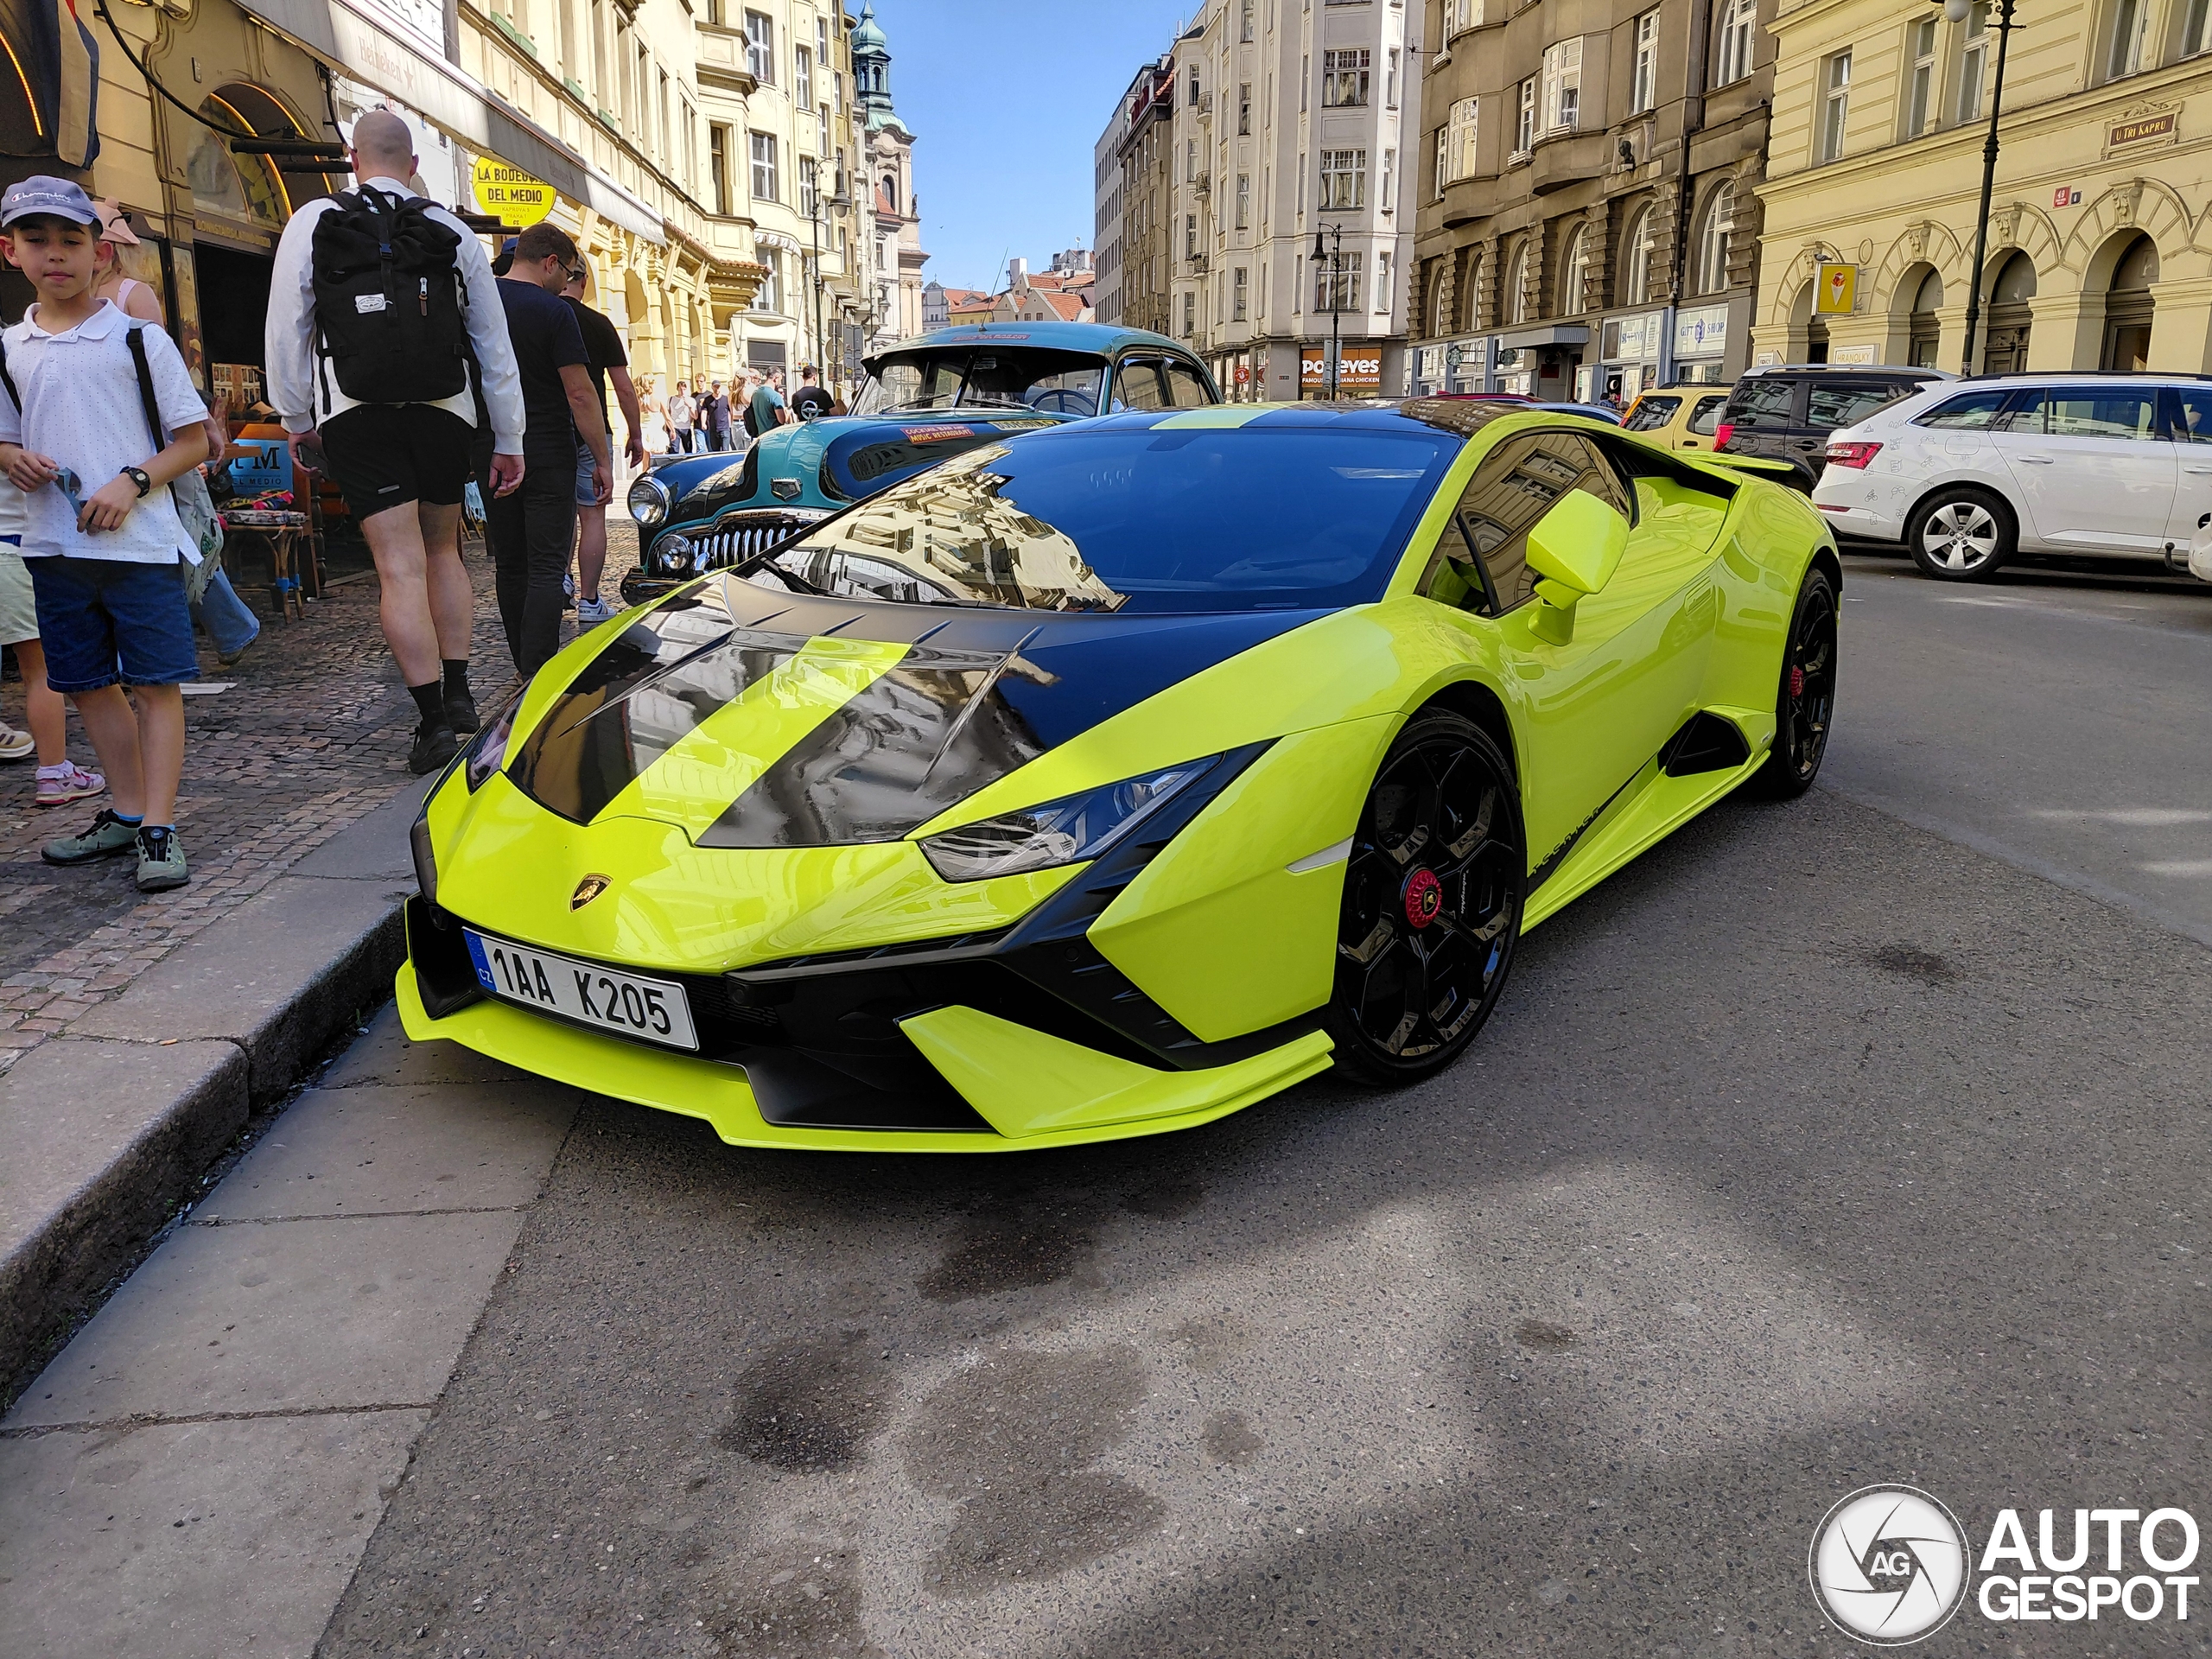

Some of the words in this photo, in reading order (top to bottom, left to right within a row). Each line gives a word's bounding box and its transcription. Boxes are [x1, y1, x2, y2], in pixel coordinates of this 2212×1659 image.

[359, 35, 403, 84] Heineken
[2116, 130, 2122, 141] U
[478, 168, 491, 181] LA
[487, 188, 506, 200] DEL
[510, 188, 543, 202] MEDIO
[1681, 326, 1694, 336] GIFT
[1707, 321, 1725, 334] SHOP
[1837, 353, 1870, 363] HRANOLKY
[910, 433, 932, 442] MUSIC
[932, 429, 972, 439] RESTAURANT
[478, 967, 493, 984] CZ
[493, 948, 556, 1006] 1AA
[573, 969, 671, 1035] K205
